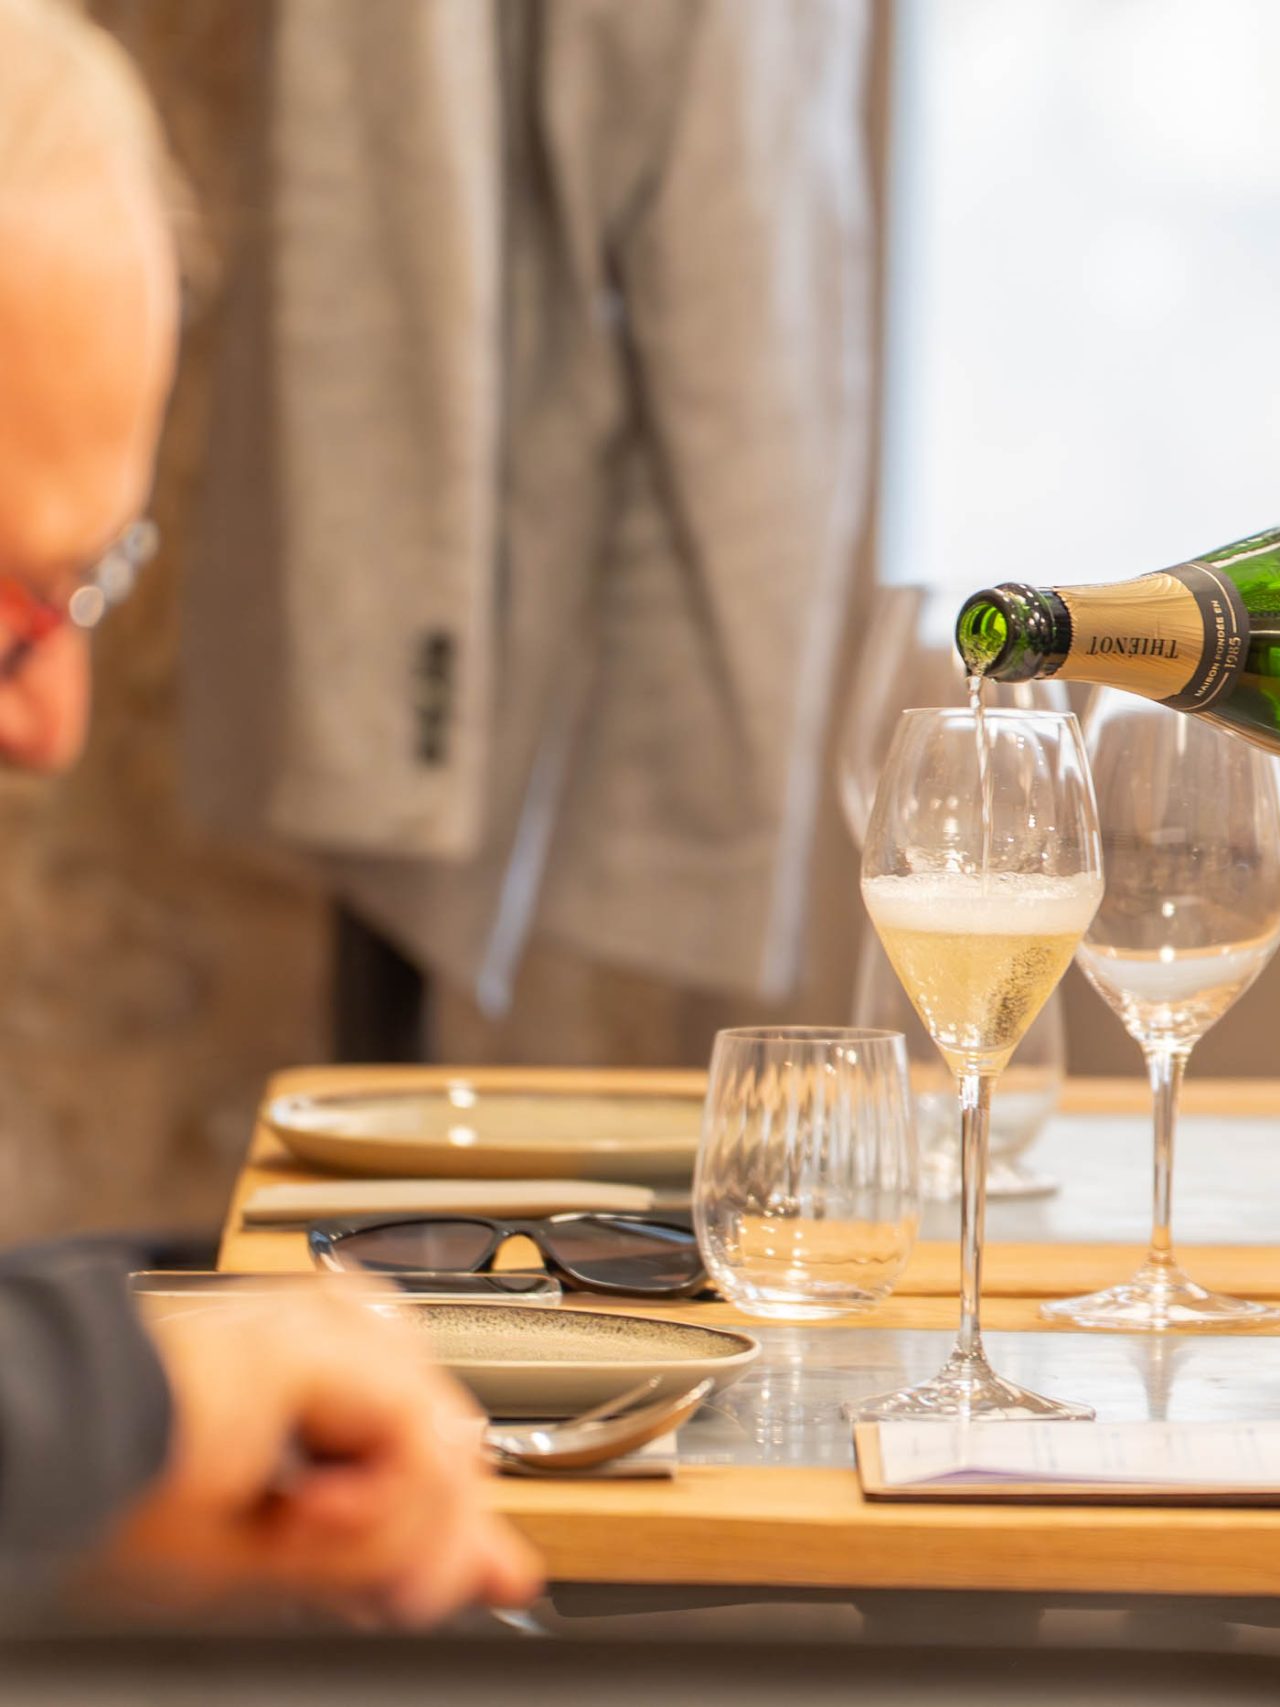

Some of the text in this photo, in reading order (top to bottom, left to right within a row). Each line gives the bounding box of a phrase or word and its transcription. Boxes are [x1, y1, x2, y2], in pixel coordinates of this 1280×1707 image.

[1086, 636, 1179, 659] THIÉNOT
[1194, 662, 1221, 697] MAISON
[1211, 600, 1223, 615] EN
[1224, 636, 1242, 669] 1985
